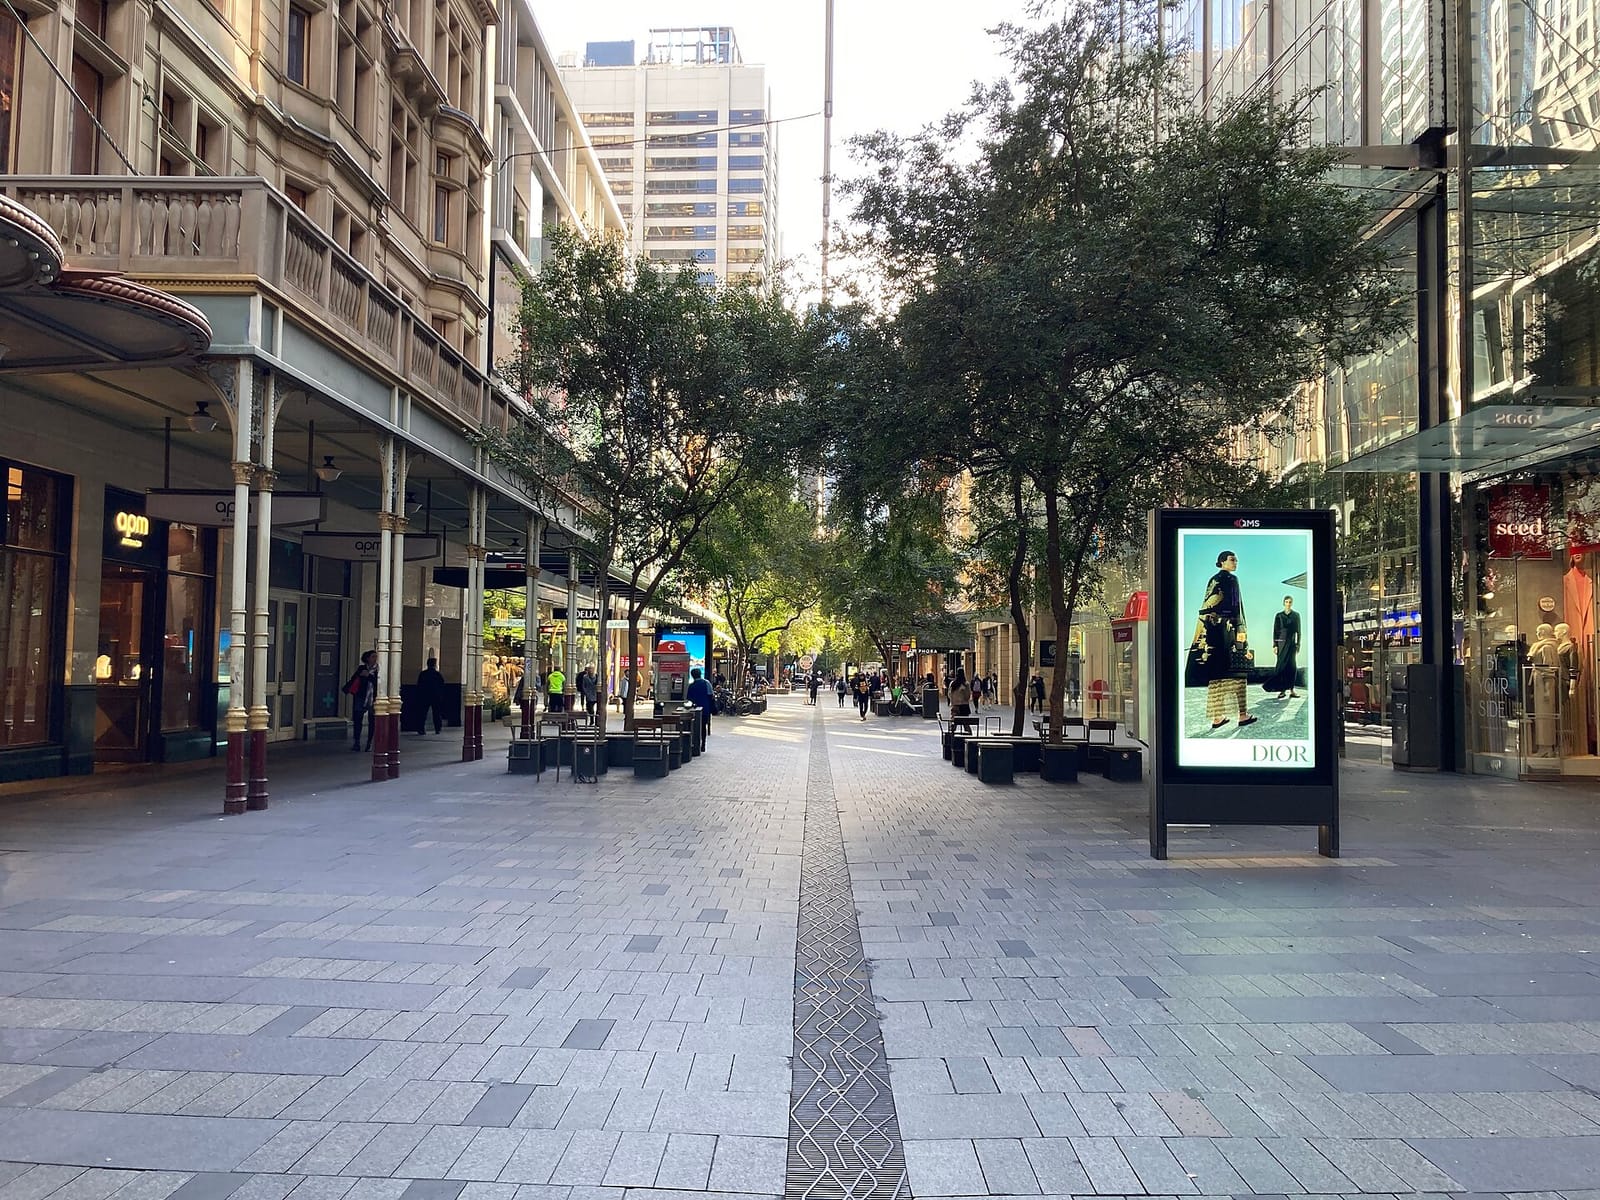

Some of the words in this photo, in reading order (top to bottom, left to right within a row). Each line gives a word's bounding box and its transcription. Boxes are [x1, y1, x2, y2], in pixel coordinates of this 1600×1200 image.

[116, 511, 149, 537] apm
[1238, 518, 1260, 528] QMS
[1496, 517, 1543, 536] seed
[1486, 653, 1499, 671] BY
[1478, 677, 1510, 695] YOUR
[1252, 745, 1309, 762] DIOR
